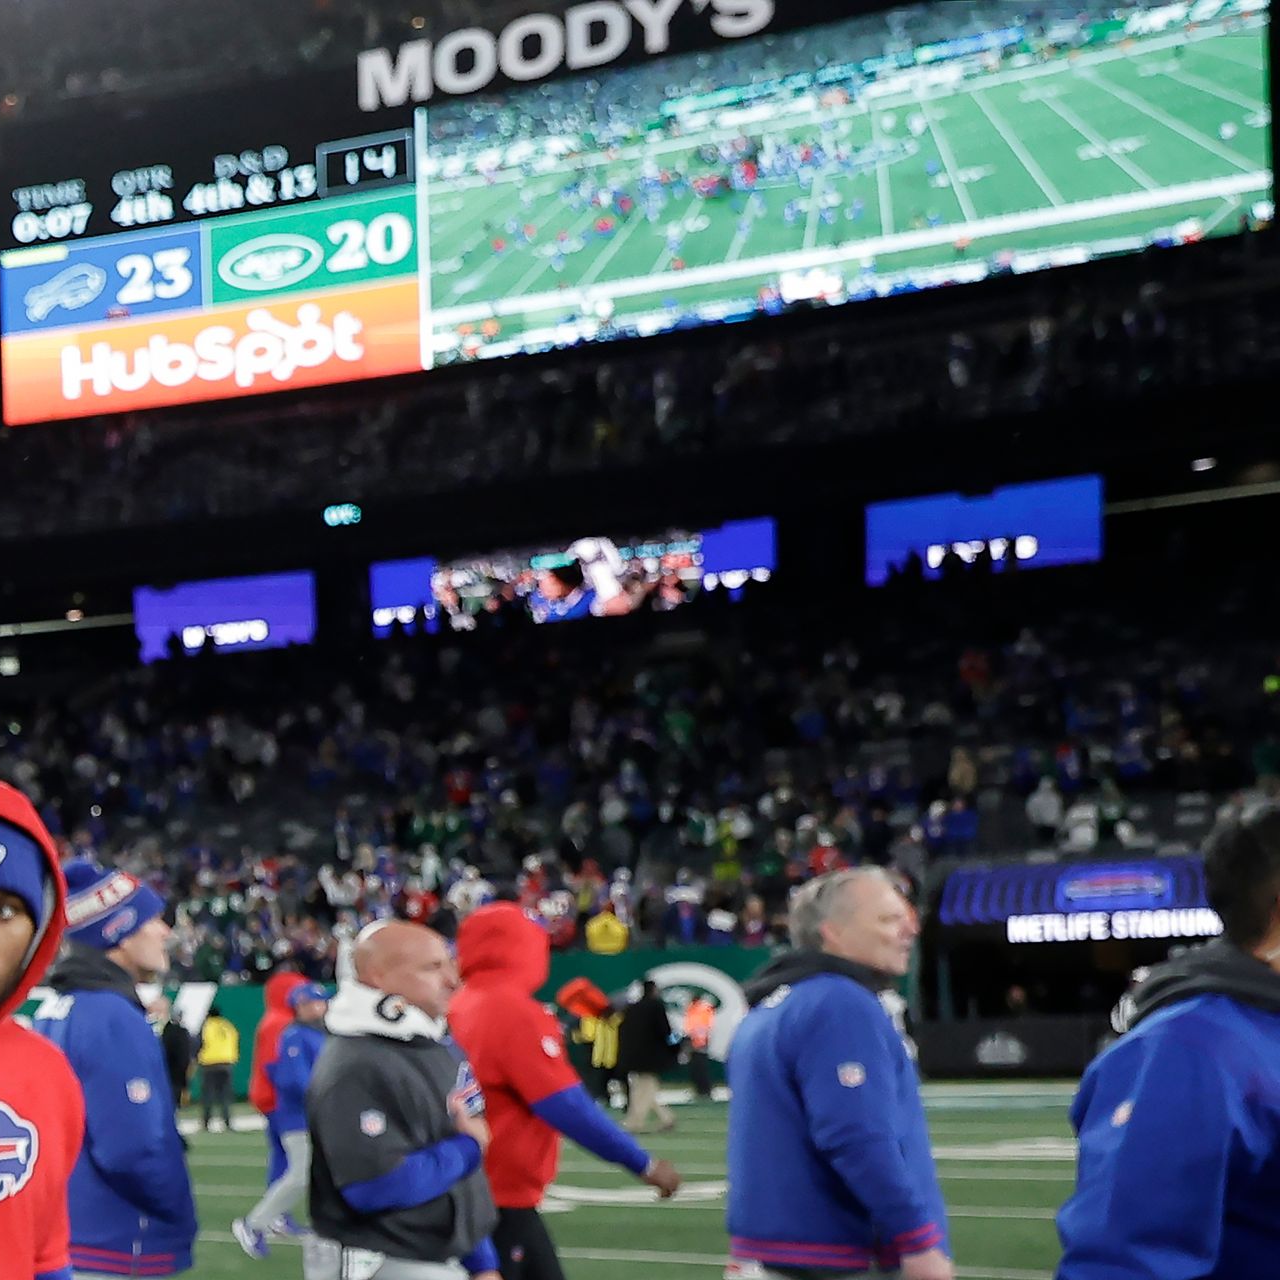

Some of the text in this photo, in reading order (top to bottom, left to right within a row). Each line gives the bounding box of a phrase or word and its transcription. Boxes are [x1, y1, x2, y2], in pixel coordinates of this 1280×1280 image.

[345, 144, 396, 186] 14
[11, 201, 93, 244] 0:07
[110, 187, 175, 227] 4th
[183, 176, 245, 216] 4th
[326, 212, 413, 274] 20
[115, 247, 193, 305] 23
[60, 303, 364, 400] HubSpot
[1007, 907, 1224, 943] METLIFE STADIUM
